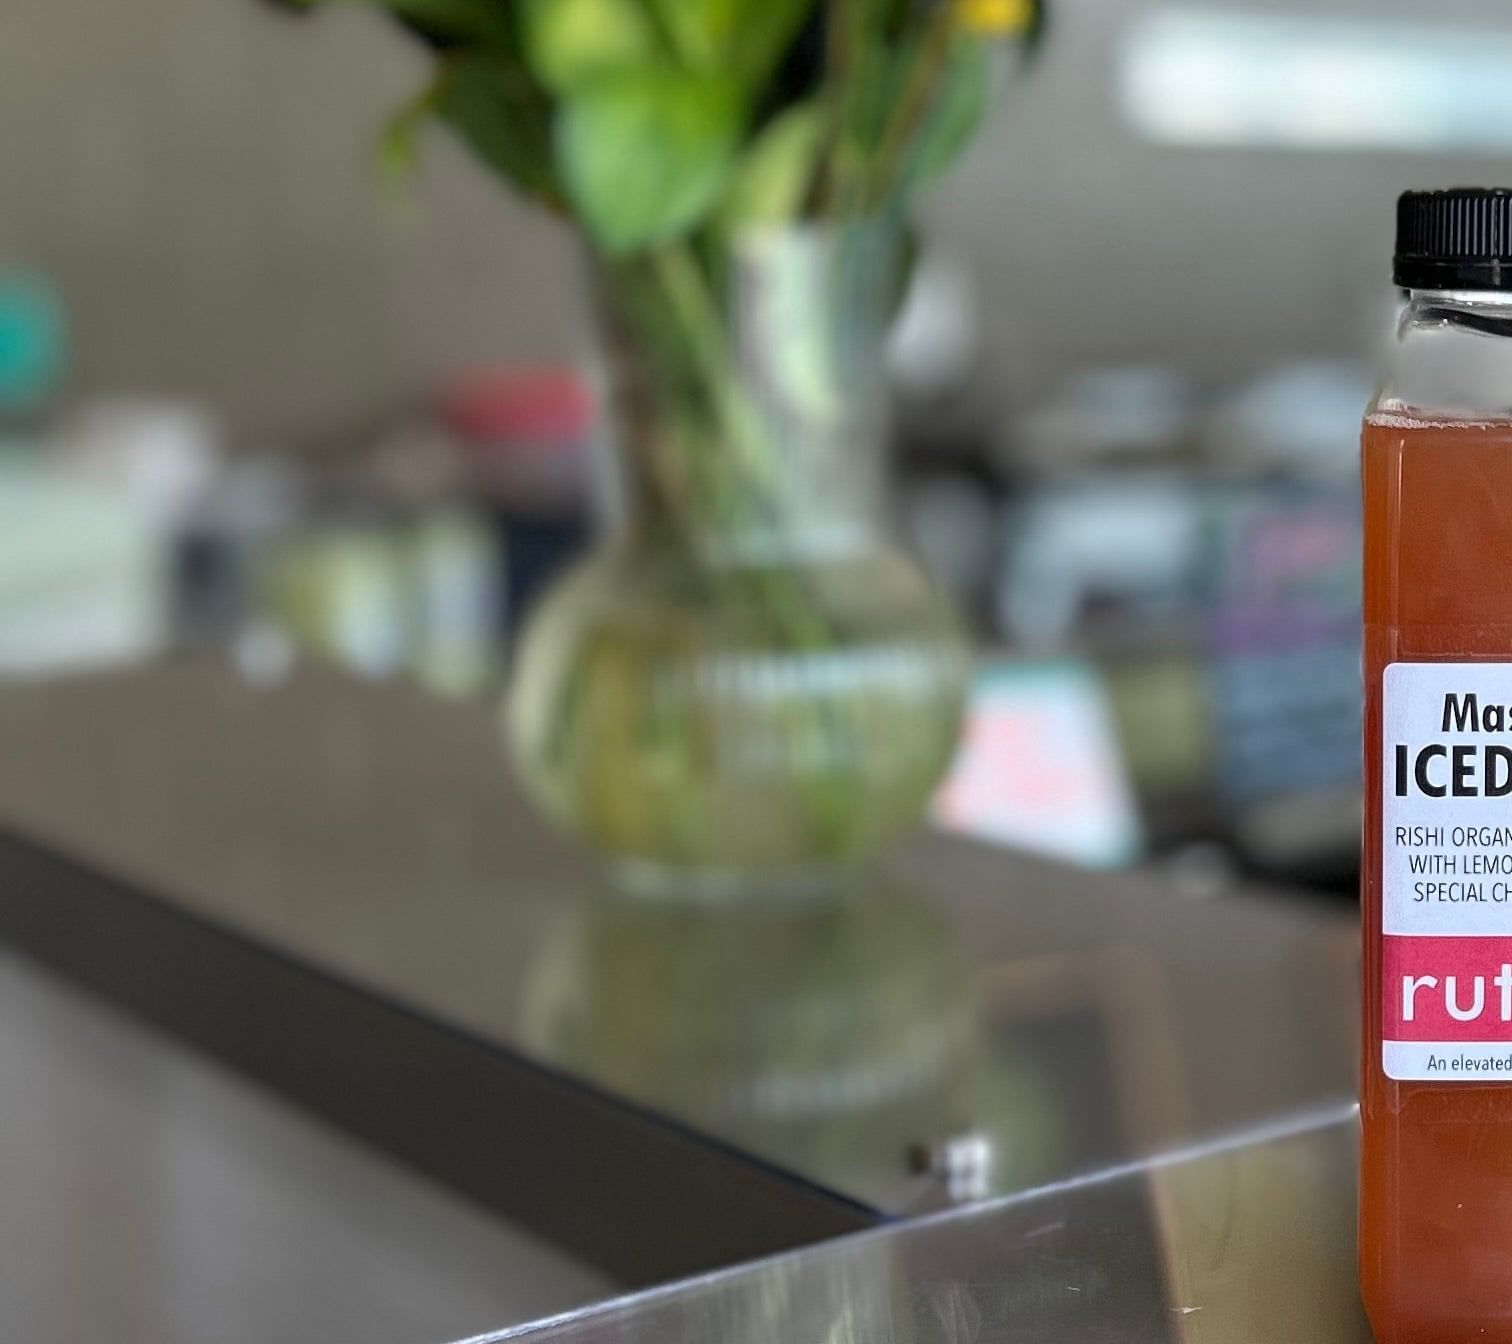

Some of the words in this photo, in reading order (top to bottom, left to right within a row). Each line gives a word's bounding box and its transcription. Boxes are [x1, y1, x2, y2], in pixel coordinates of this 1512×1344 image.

[1396, 827, 1443, 846] RISHI
[1409, 855, 1456, 874] WITH
[1414, 882, 1487, 902] SPECIAL
[1428, 1055, 1446, 1070] An
[1452, 1055, 1512, 1070] elevated
